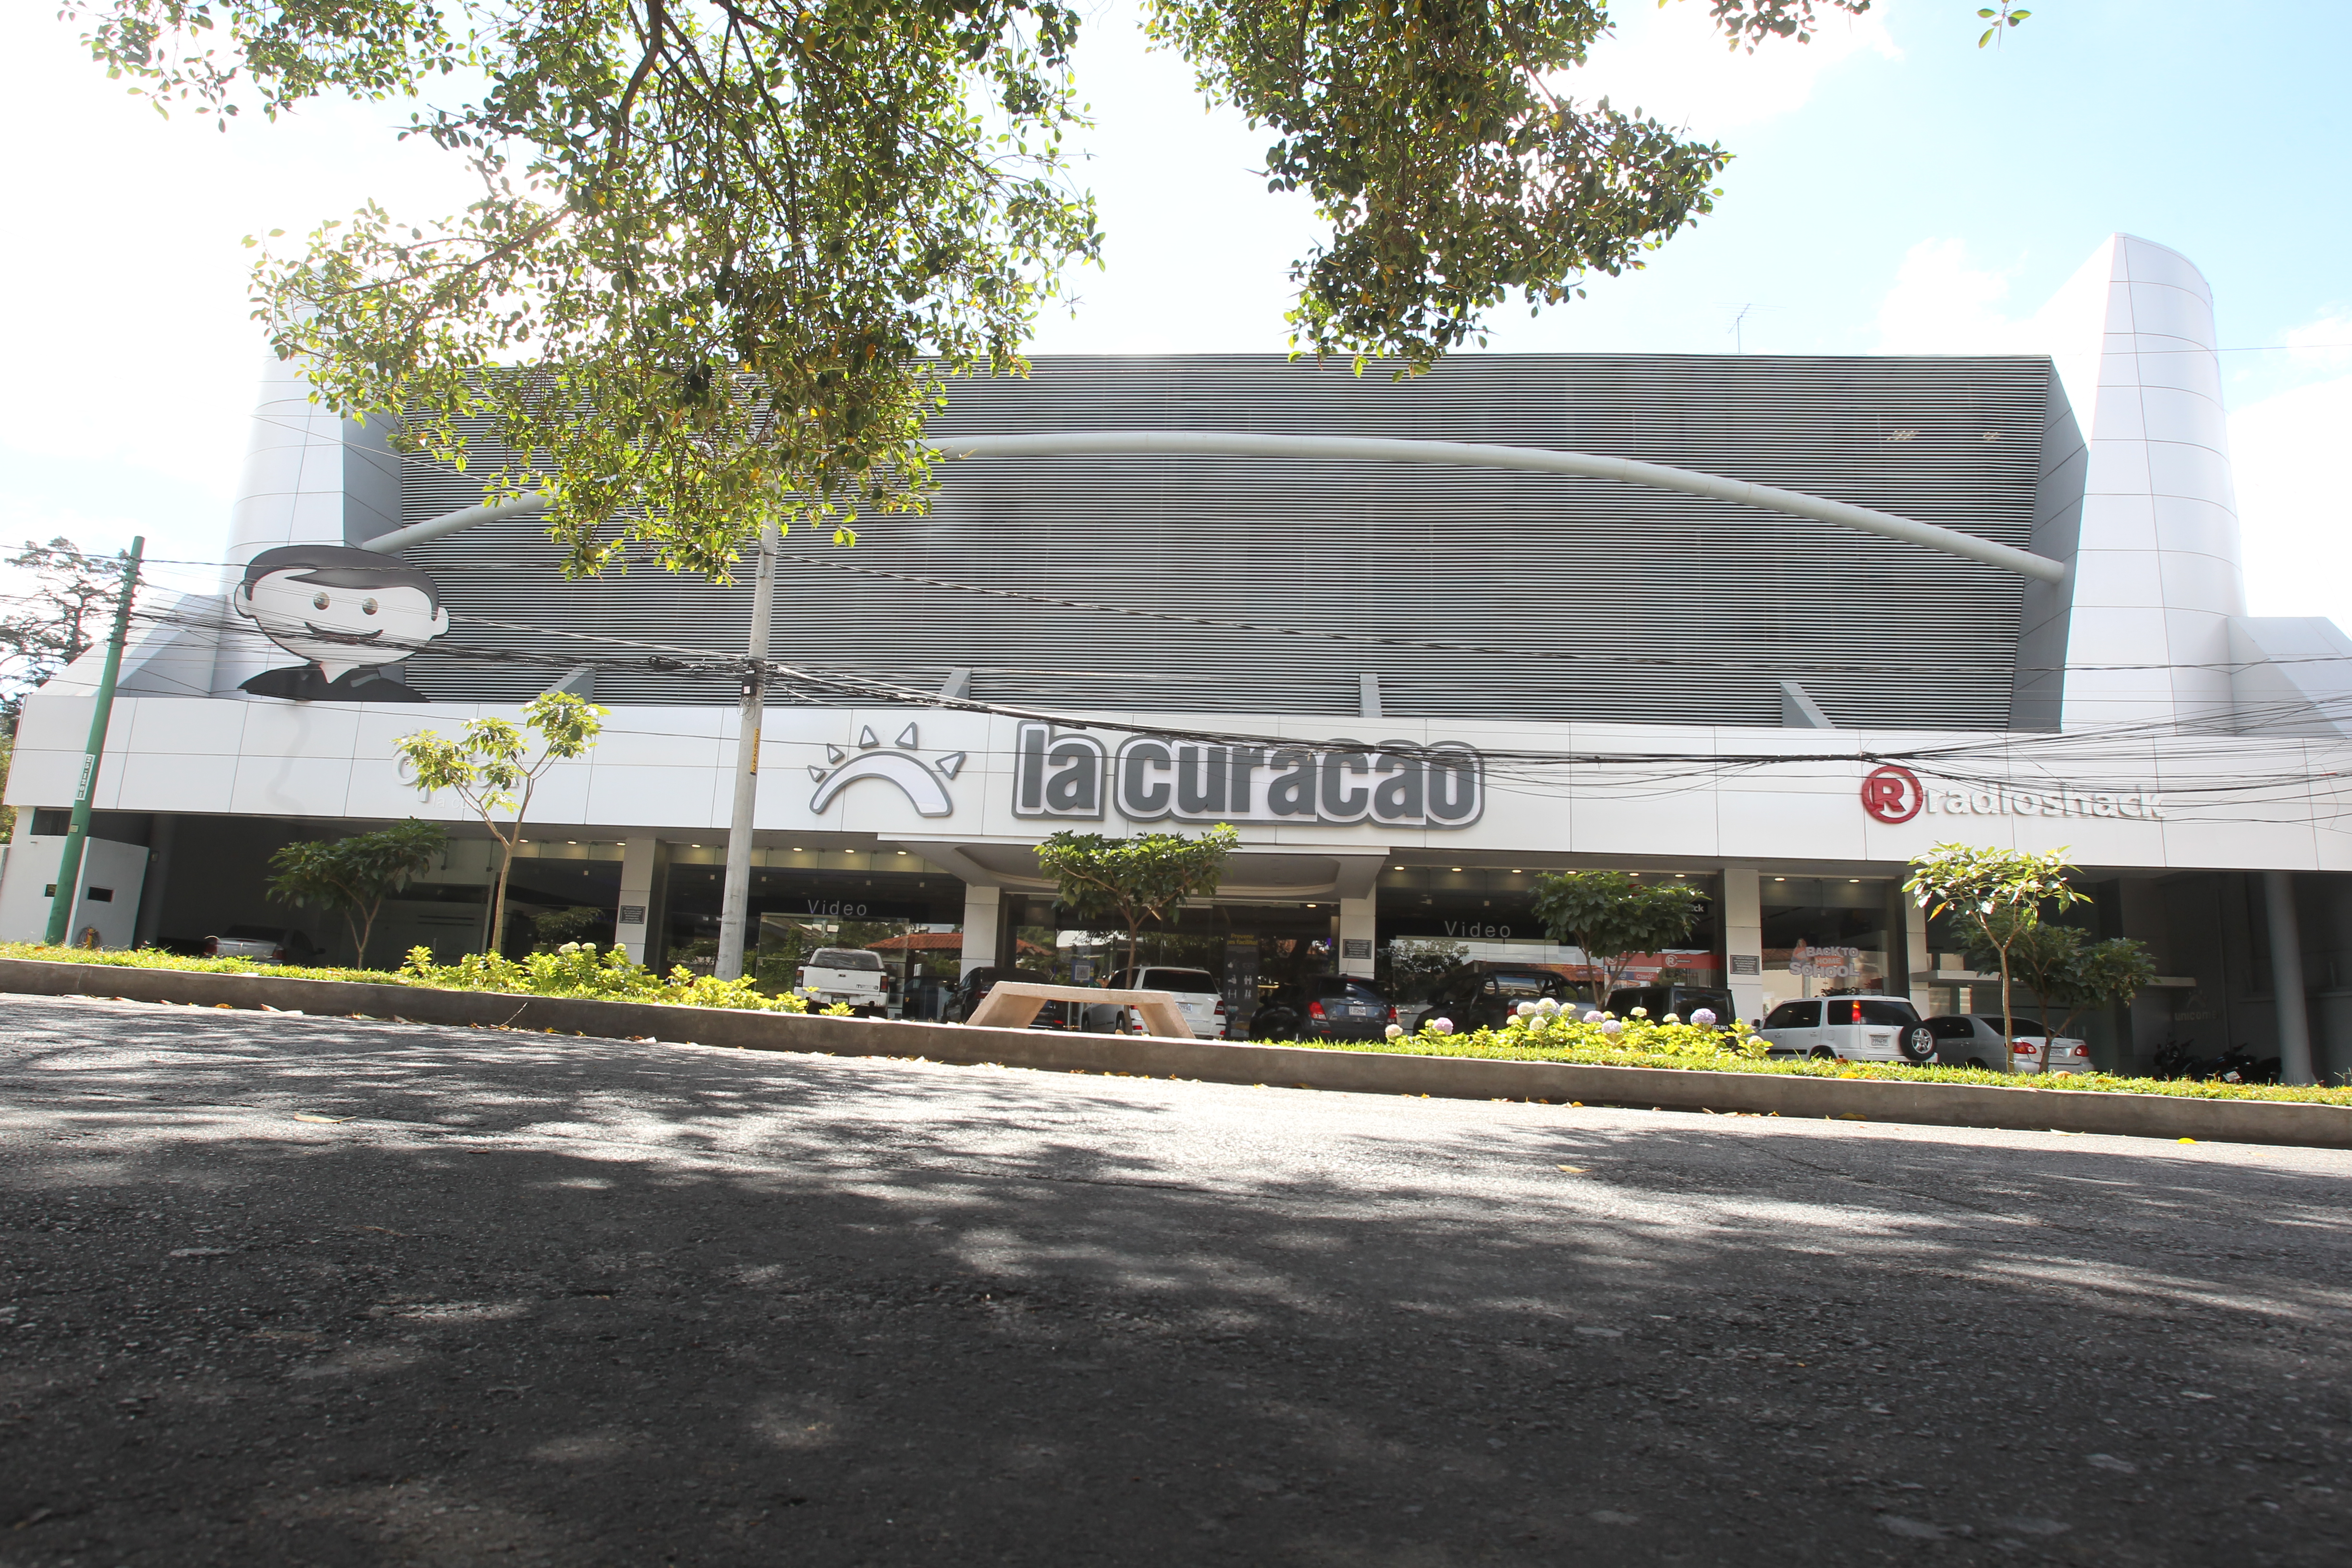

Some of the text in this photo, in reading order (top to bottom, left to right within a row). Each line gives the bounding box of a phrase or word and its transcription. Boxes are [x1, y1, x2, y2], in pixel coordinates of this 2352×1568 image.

[79, 757, 92, 797] 25-1201
[1021, 728, 1476, 820] la curacao
[1927, 783, 2168, 818] radioshack
[808, 899, 867, 916] Video
[1444, 920, 1510, 937] Video
[1805, 946, 1860, 957] BACK TO
[1789, 962, 1860, 978] SCHOOL
